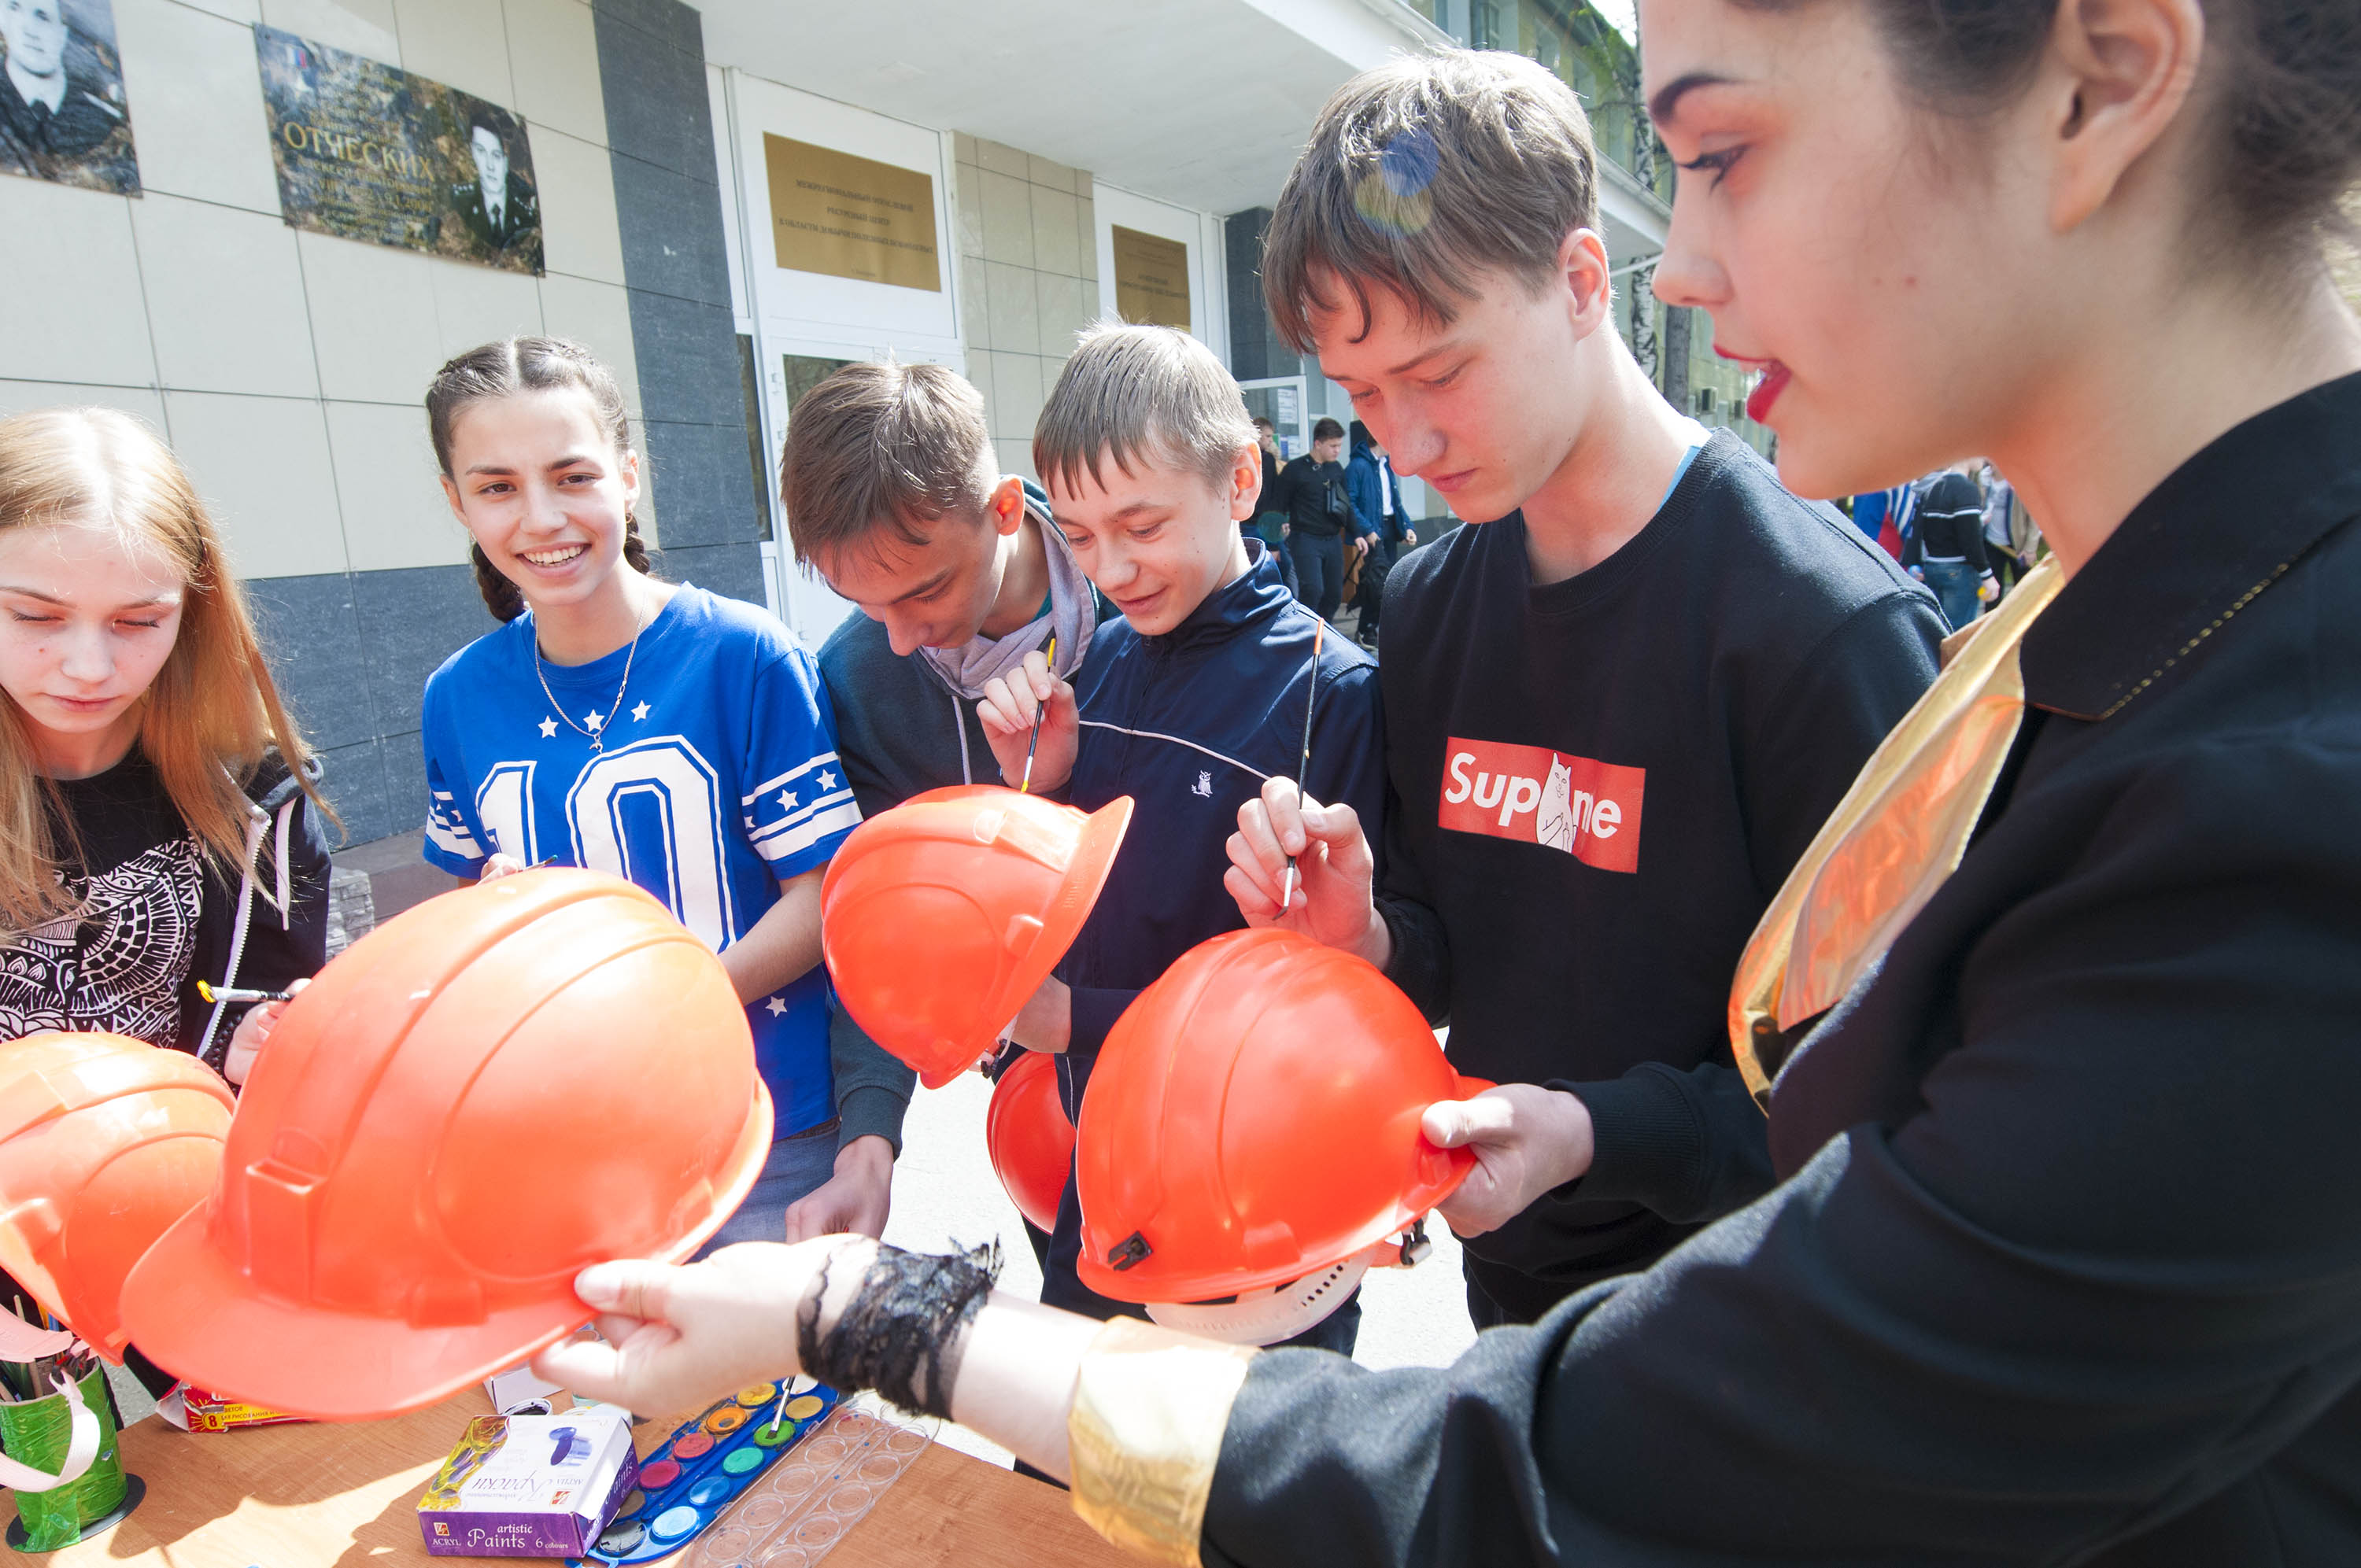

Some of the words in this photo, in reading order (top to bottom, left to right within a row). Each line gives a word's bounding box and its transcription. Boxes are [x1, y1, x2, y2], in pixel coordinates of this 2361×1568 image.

[283, 121, 434, 183] ОТЧЕСКИХ
[475, 735, 736, 955] 10
[208, 1415, 217, 1427] 8
[497, 1523, 533, 1534] artistic
[433, 1538, 461, 1547] ACRYL
[467, 1529, 526, 1548] Paints
[535, 1538, 543, 1548] 6
